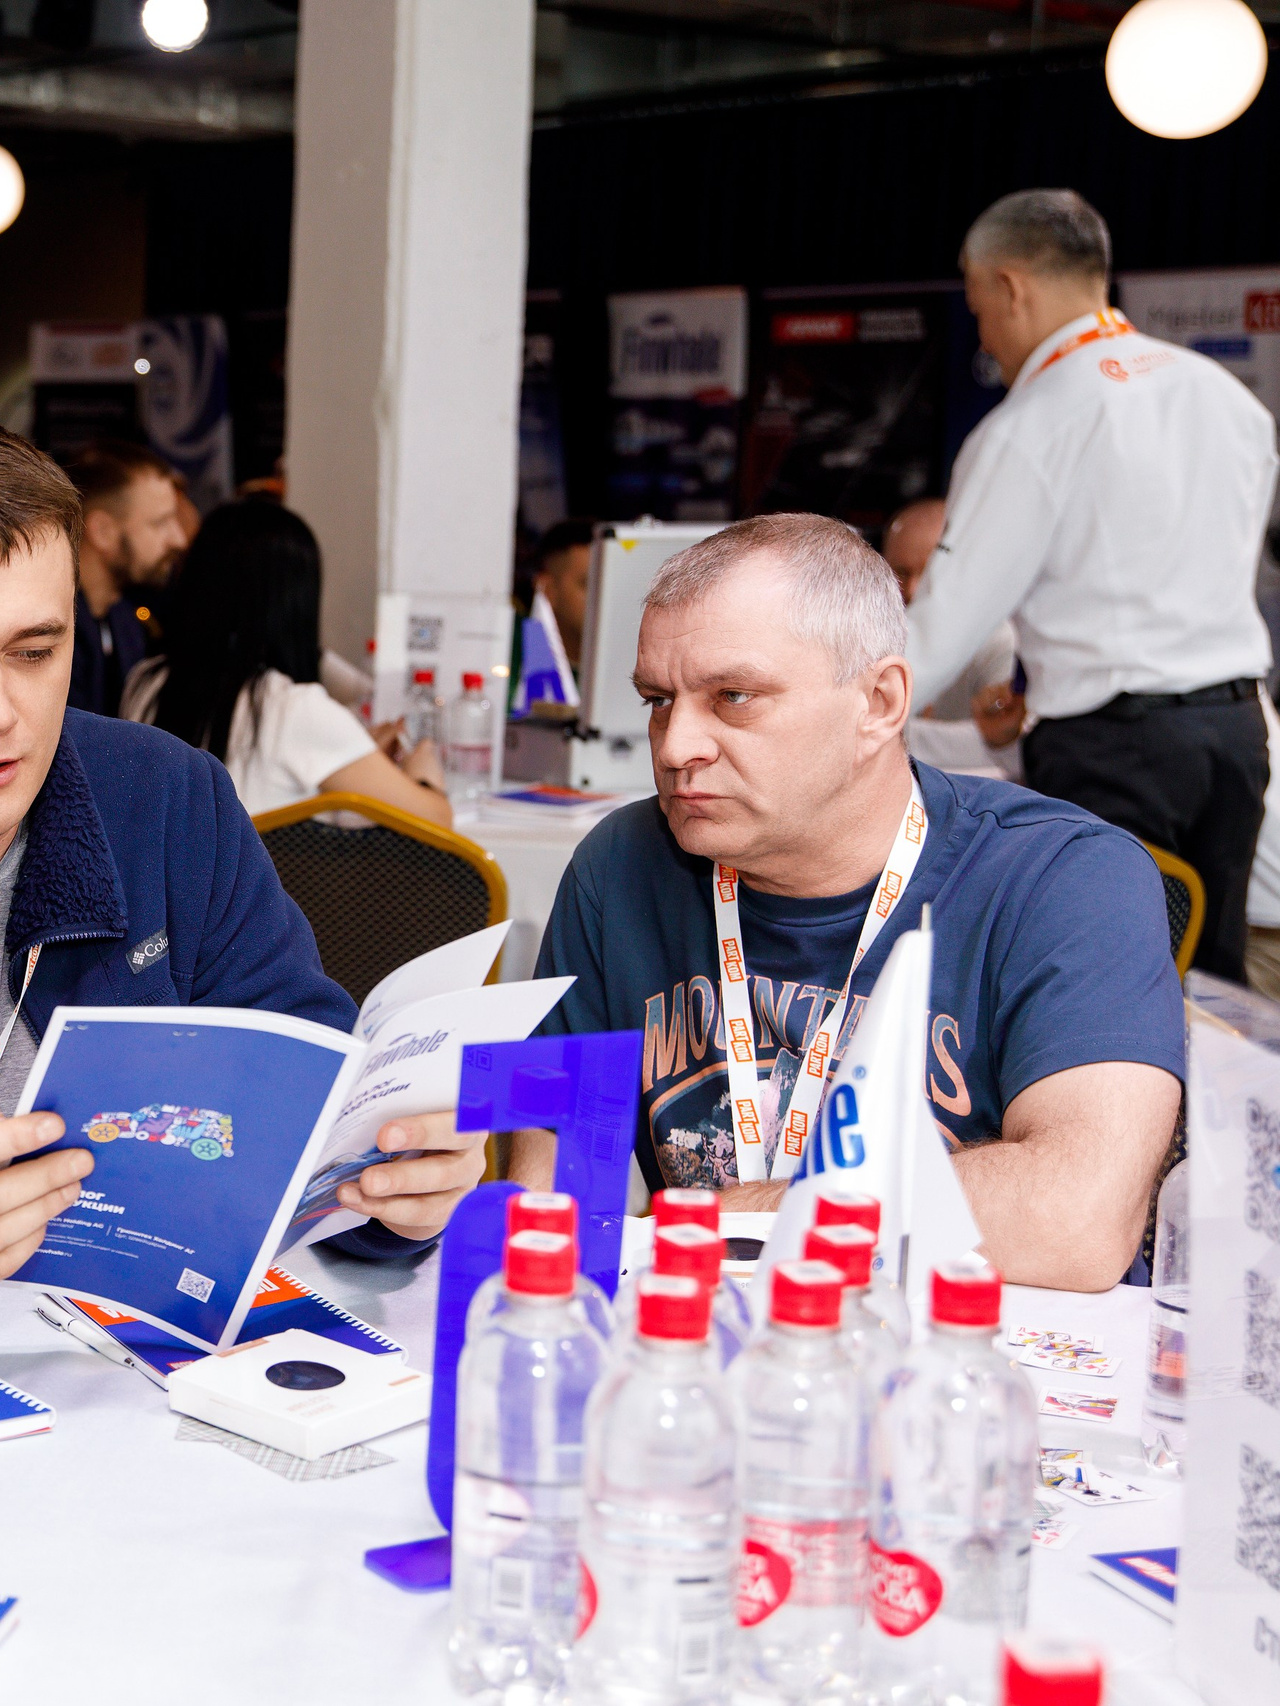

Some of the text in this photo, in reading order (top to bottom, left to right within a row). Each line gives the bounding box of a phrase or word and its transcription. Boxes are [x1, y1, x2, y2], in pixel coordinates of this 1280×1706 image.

[723, 940, 742, 980] PART KOM
[730, 1019, 751, 1061] PART KOM
[808, 1034, 829, 1077] PART KOM
[737, 1100, 759, 1143] PART KOM
[785, 1111, 807, 1155] PART KOM
